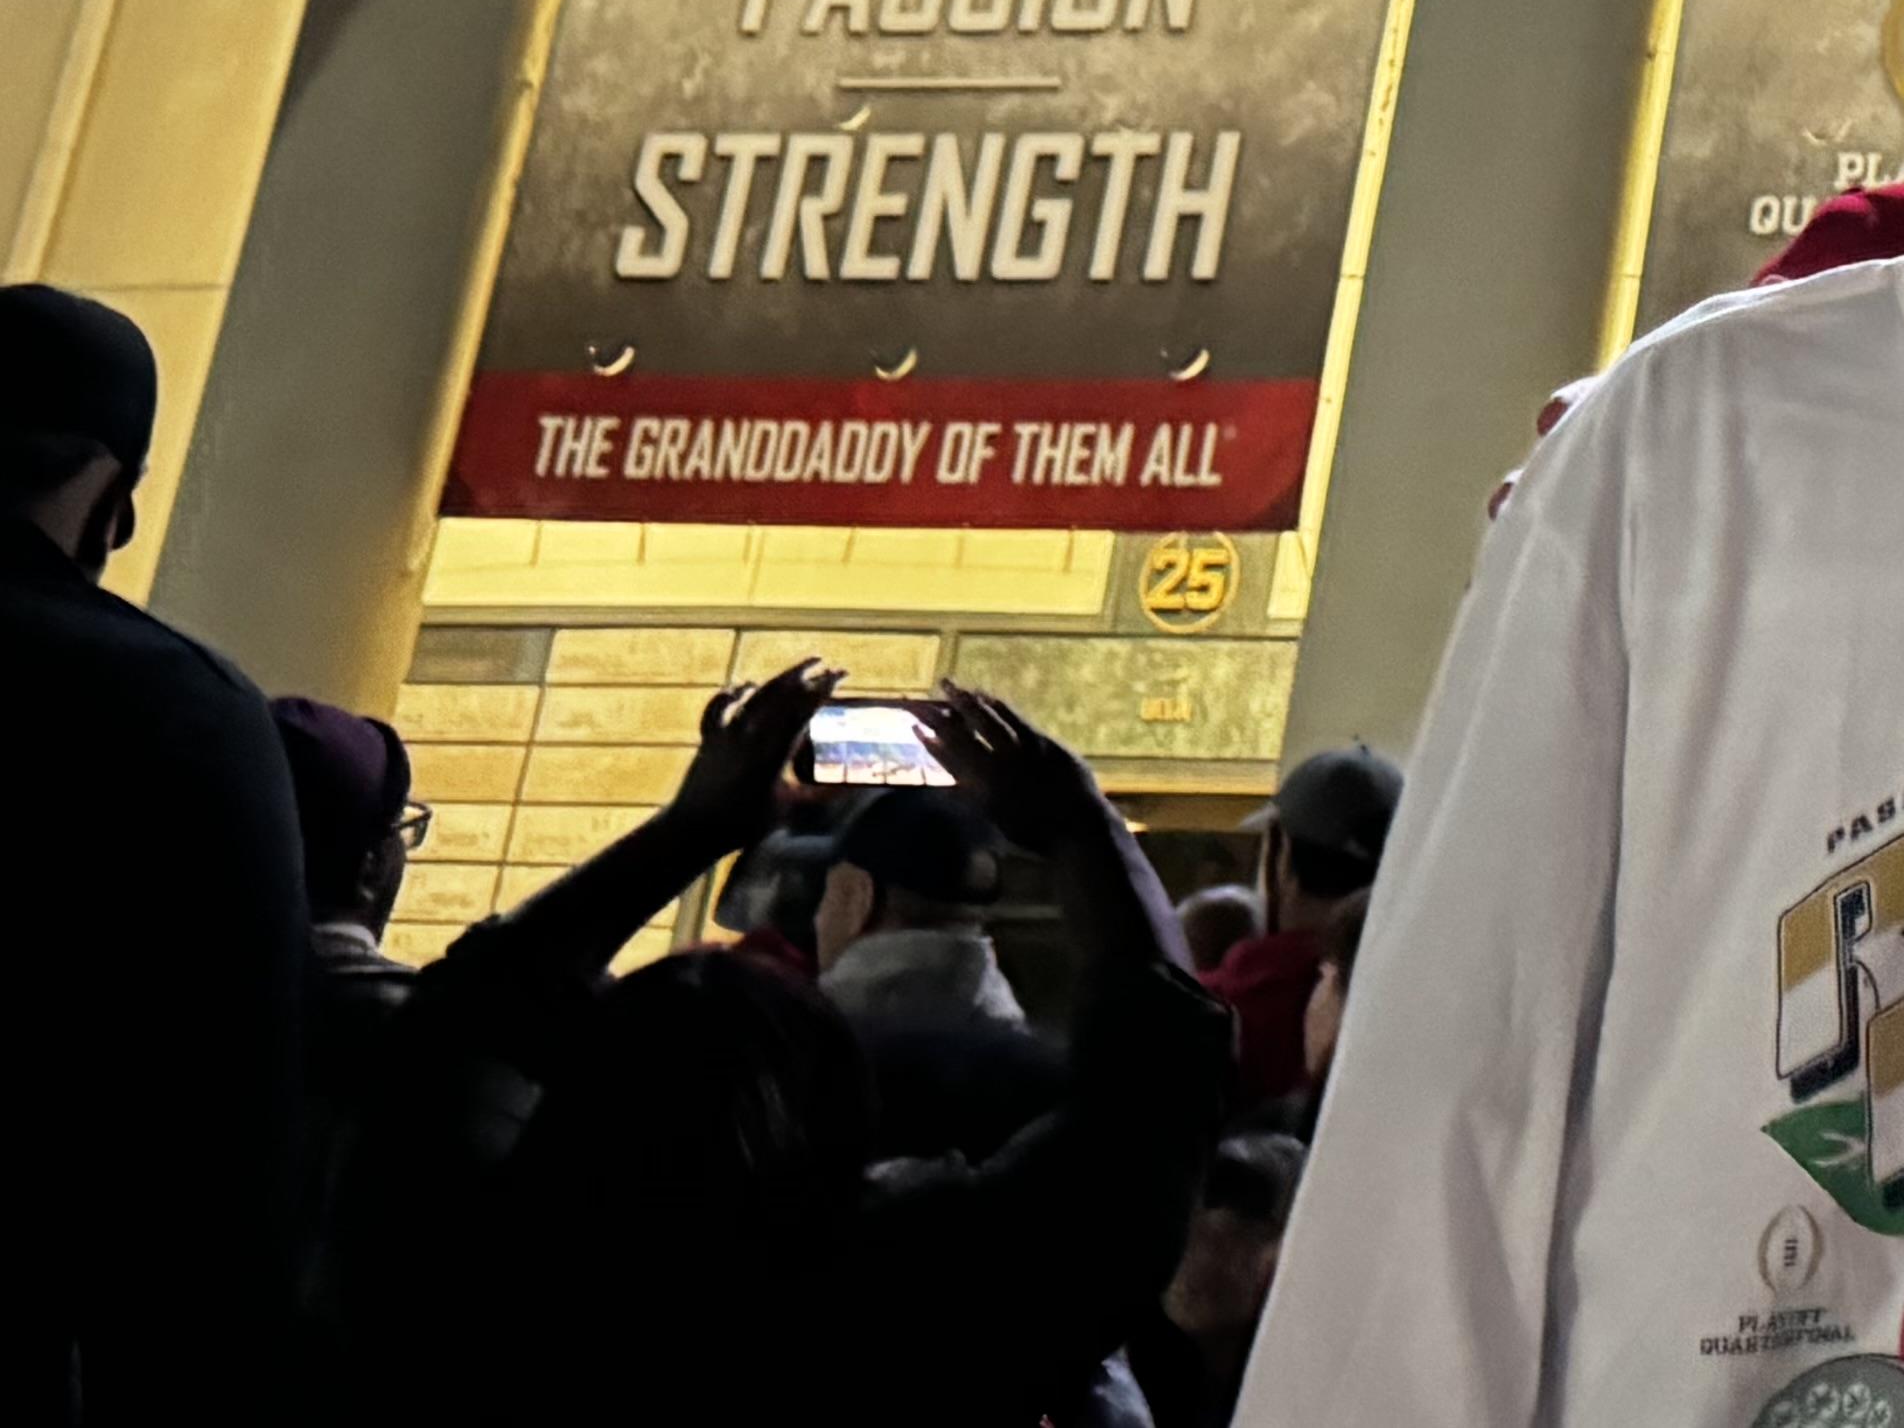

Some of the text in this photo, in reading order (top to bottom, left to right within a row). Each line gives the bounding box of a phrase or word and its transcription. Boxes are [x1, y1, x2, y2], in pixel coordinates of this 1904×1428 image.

[615, 130, 1241, 281] STRENGTH
[534, 416, 1223, 486] THE GRANDDADDY OF THEM ALL
[1145, 547, 1231, 611] 25
